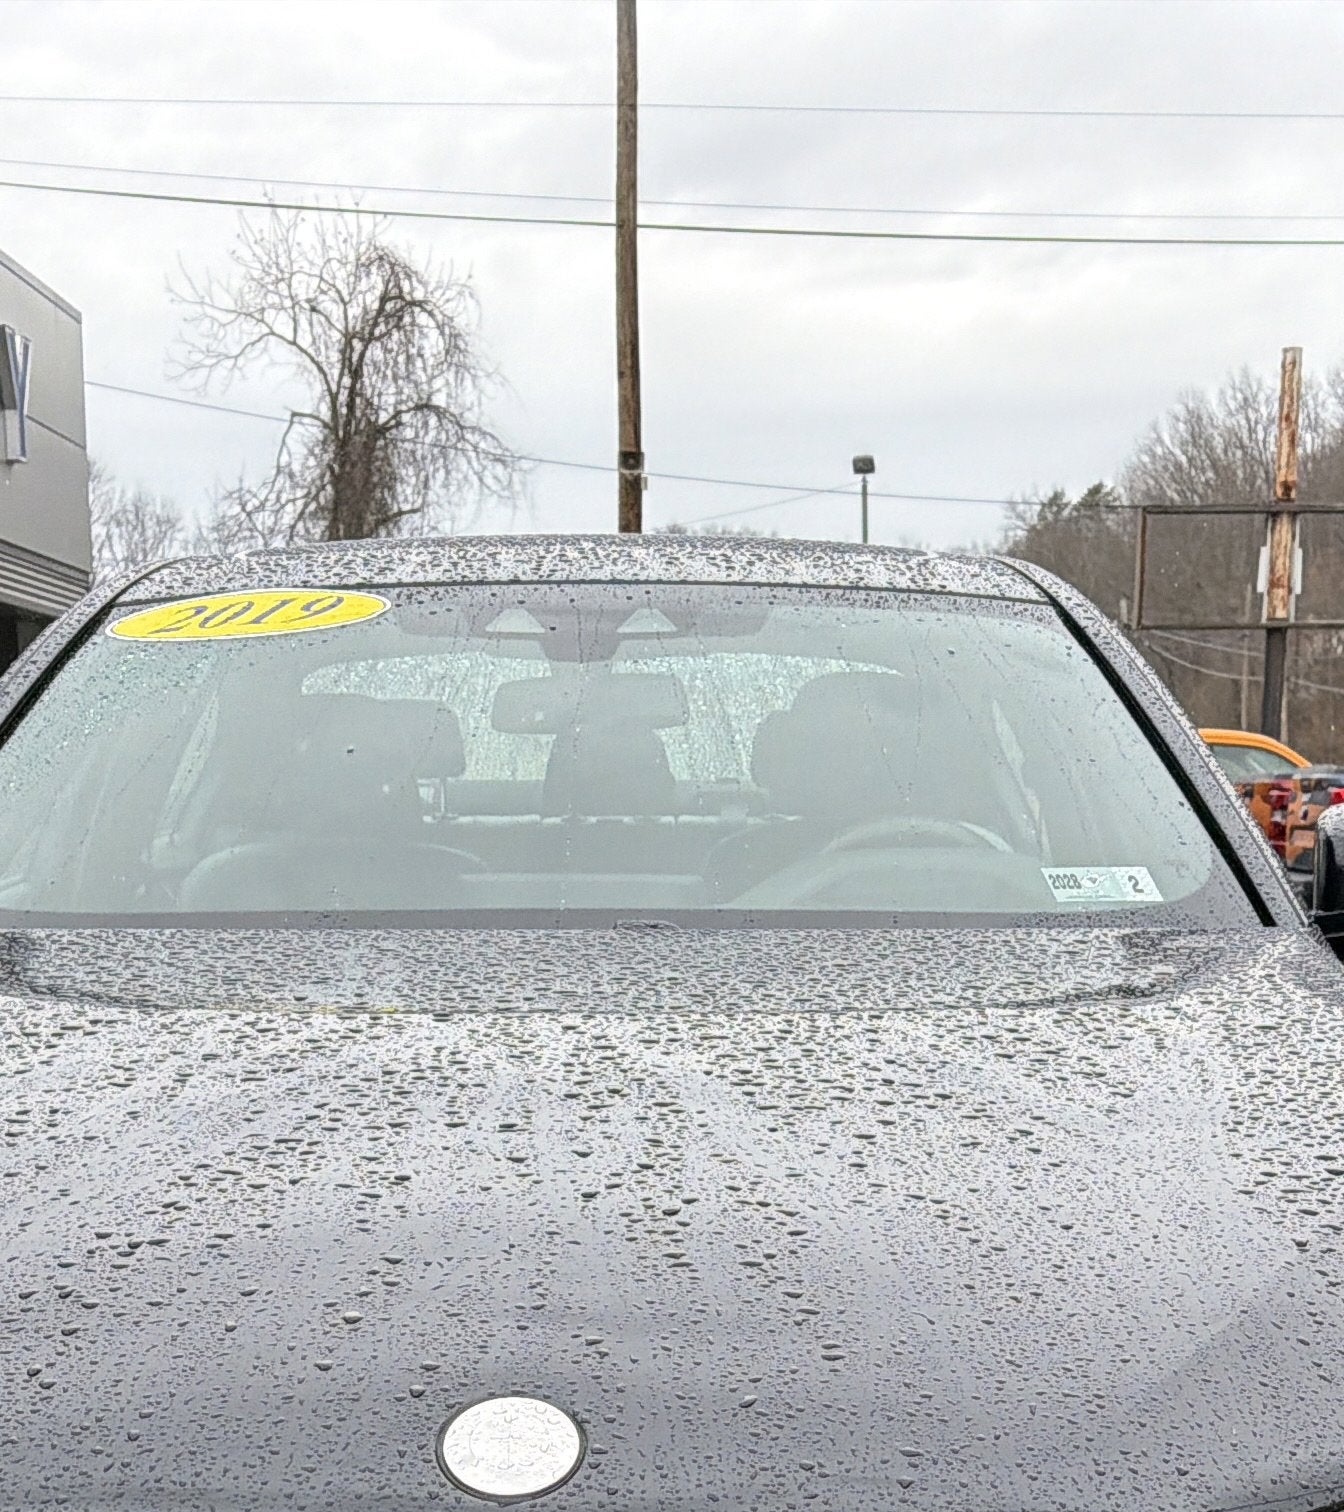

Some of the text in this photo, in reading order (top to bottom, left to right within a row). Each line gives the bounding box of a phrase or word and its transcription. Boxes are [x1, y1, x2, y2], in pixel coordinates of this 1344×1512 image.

[148, 595, 345, 635] 2019
[1048, 873, 1145, 894] 2028 2
